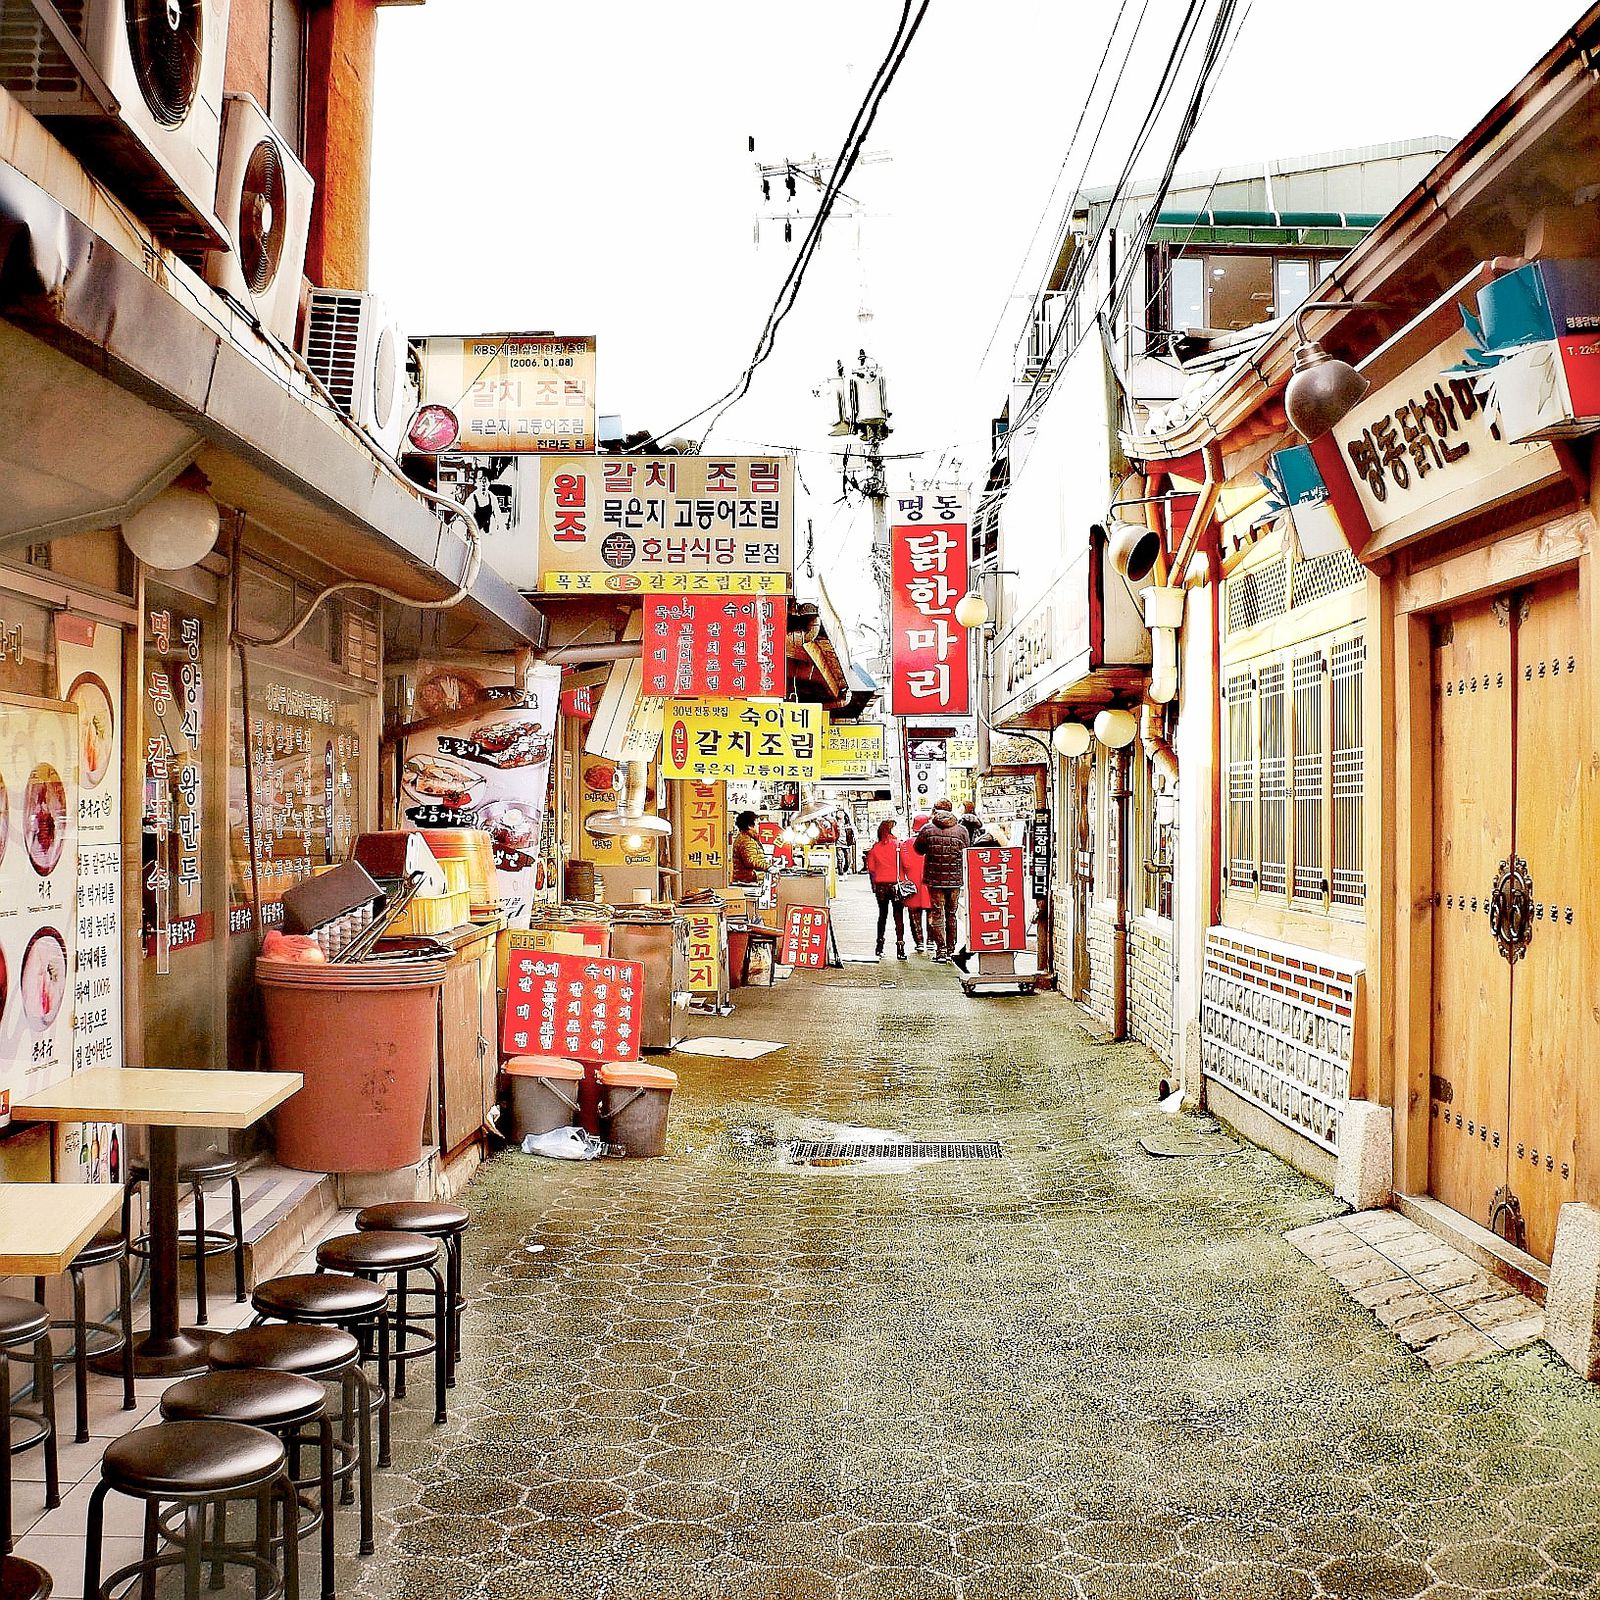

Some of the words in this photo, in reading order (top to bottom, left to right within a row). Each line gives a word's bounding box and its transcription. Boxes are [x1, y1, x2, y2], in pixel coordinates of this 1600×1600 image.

[474, 345, 496, 356] KBS
[473, 380, 522, 408] 갈치
[536, 380, 586, 408] 조림
[471, 418, 510, 436] 묵은지
[517, 418, 584, 436] 고등어조림
[536, 440, 569, 450] 전라도
[574, 440, 585, 450] 집
[604, 462, 676, 493] 갈치
[706, 462, 780, 493] 조림
[554, 474, 586, 542] 원조
[604, 498, 665, 528] 묵은지
[674, 500, 779, 530] 고등어조림
[898, 496, 962, 521] 명동
[642, 538, 736, 564] 호남식당
[744, 544, 780, 564] 본점
[556, 575, 592, 590] 목포
[655, 606, 695, 619] 묵은지
[905, 530, 958, 706] 닭한마리
[706, 623, 721, 690] 갈치조림
[733, 623, 747, 690] 생선구이
[180, 618, 201, 750] 평양식
[672, 706, 692, 717] 30년
[740, 707, 809, 728] 숙이네
[674, 728, 686, 763] 원조
[695, 729, 814, 759] 갈치조림
[693, 764, 735, 776] 묵은지
[178, 766, 201, 897] 왕만두
[688, 852, 722, 866] 백반
[977, 851, 1013, 863] 명동
[980, 866, 1015, 950] 닭한마리
[690, 918, 714, 988] 불꼬지
[584, 963, 632, 983] 숙이네
